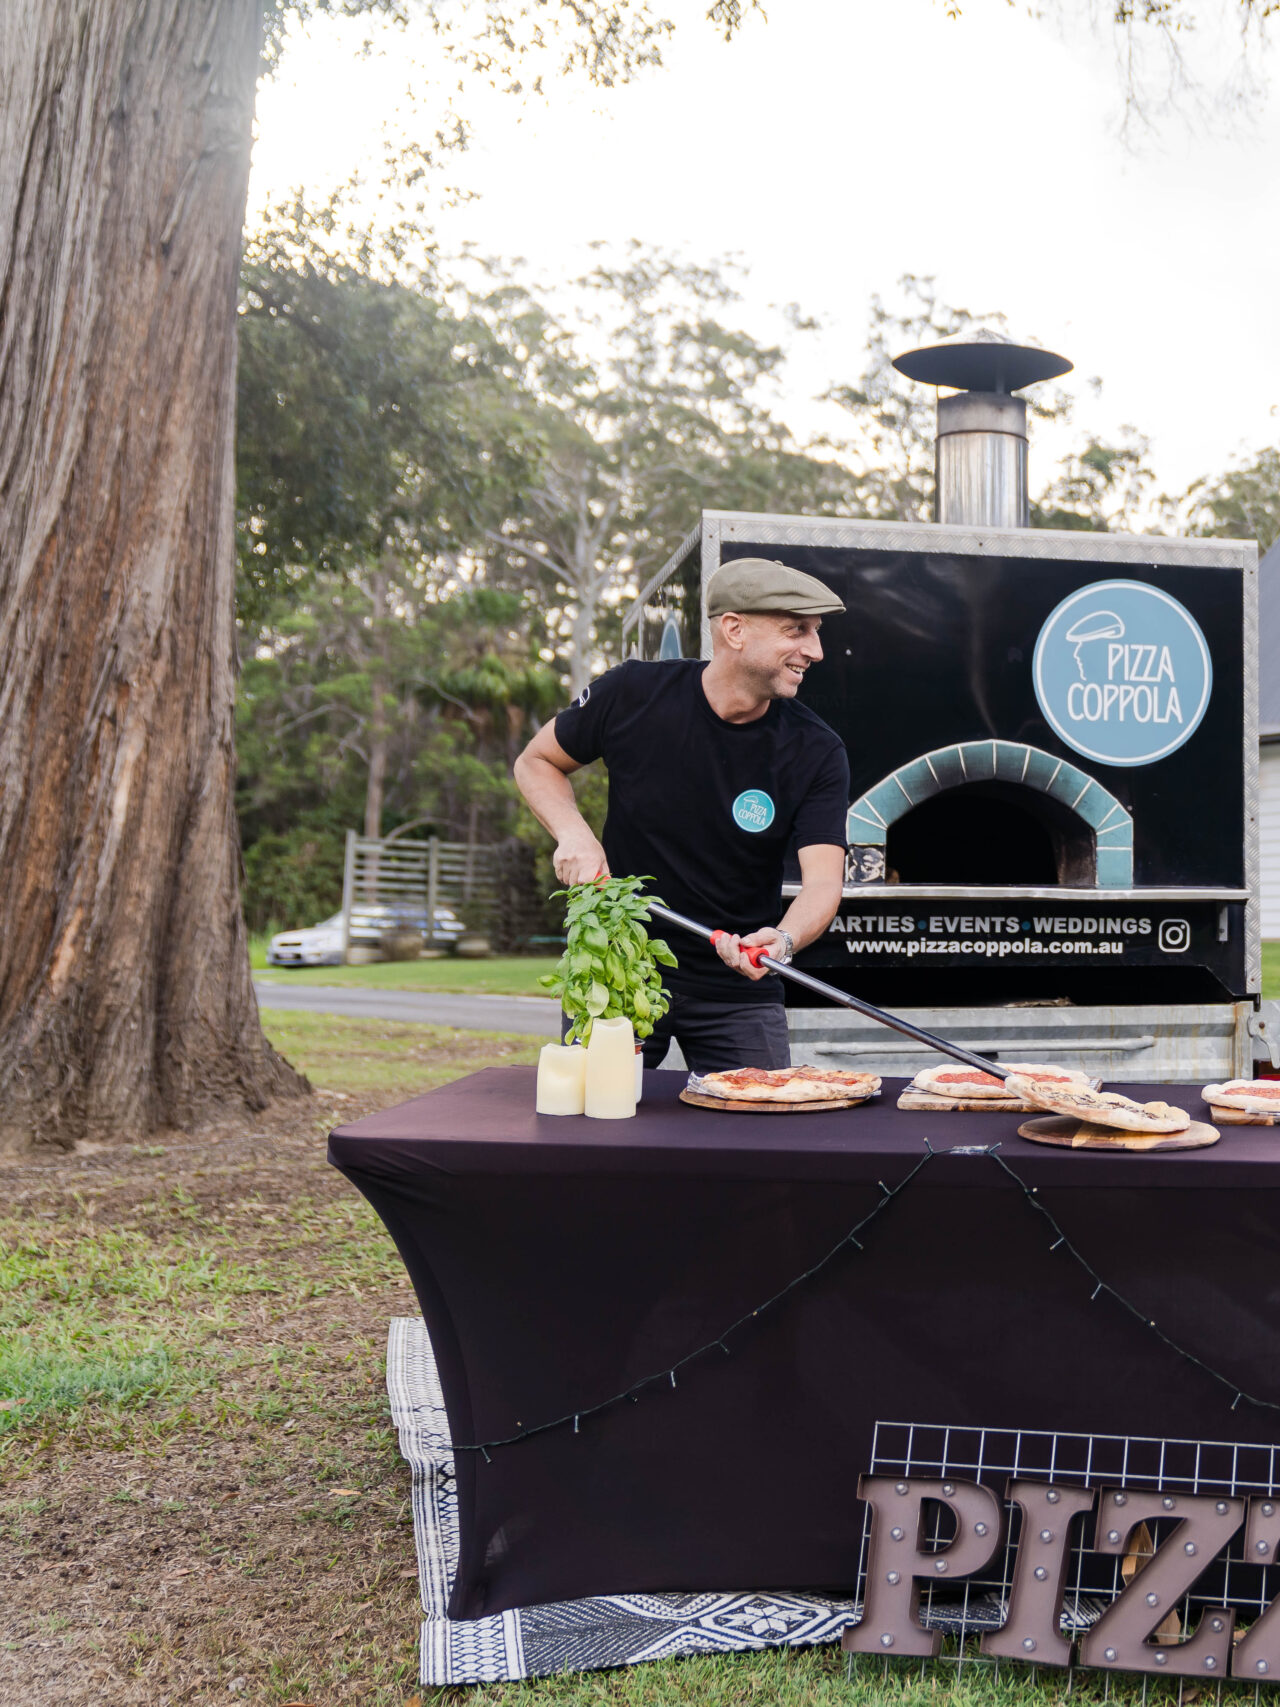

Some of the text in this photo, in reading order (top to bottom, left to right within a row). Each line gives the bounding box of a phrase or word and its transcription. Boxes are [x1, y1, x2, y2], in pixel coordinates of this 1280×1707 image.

[1108, 643, 1175, 683] PIZZA
[1067, 682, 1183, 724] COPPOLA
[738, 808, 766, 826] COPPOLA
[750, 803, 767, 817] PIZZA
[828, 915, 1152, 935] ARTIES EVENTS WEDDINGS
[846, 937, 1124, 957] www.pizzacoppola.com.au
